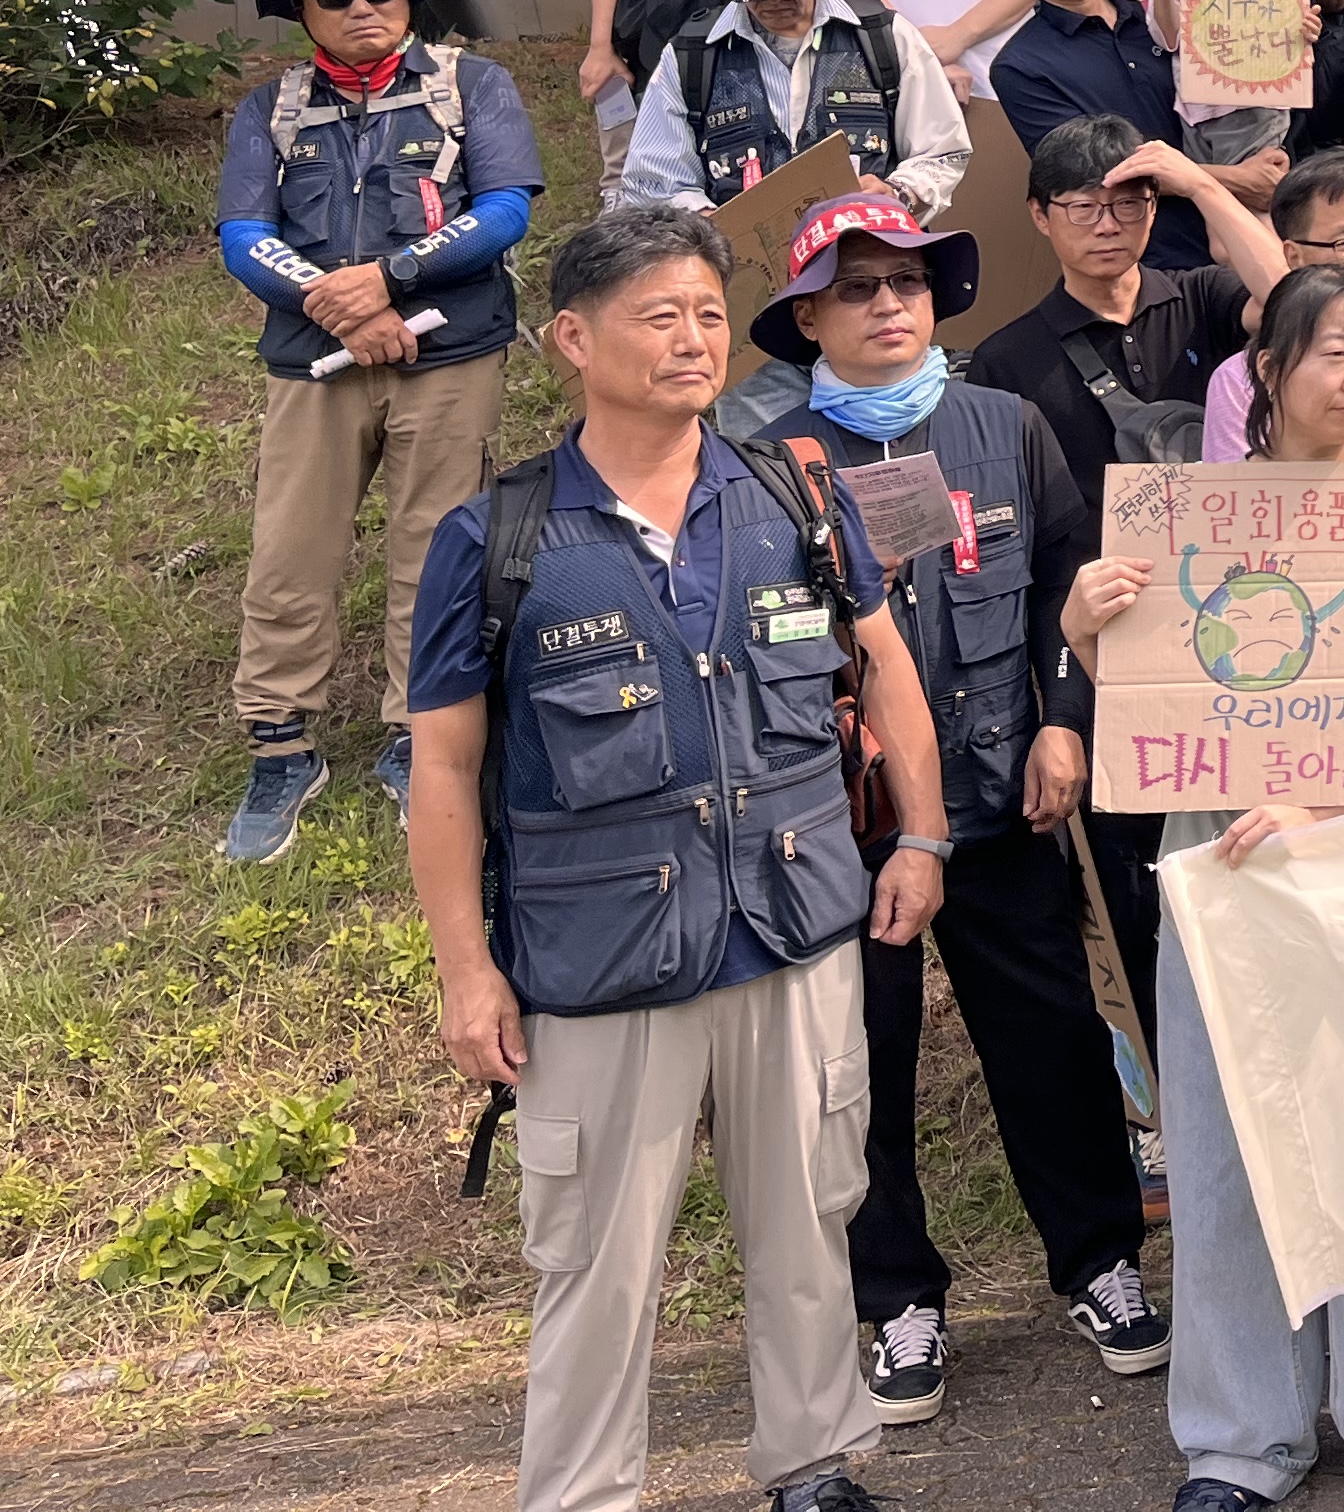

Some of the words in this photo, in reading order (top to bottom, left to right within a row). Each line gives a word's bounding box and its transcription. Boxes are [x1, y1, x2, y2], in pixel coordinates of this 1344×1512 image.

[408, 214, 479, 257] ORTS
[793, 219, 829, 263] 단결
[1115, 466, 1178, 522] 편리하게
[542, 615, 622, 651] 단결투쟁
[1131, 733, 1229, 795] 다시
